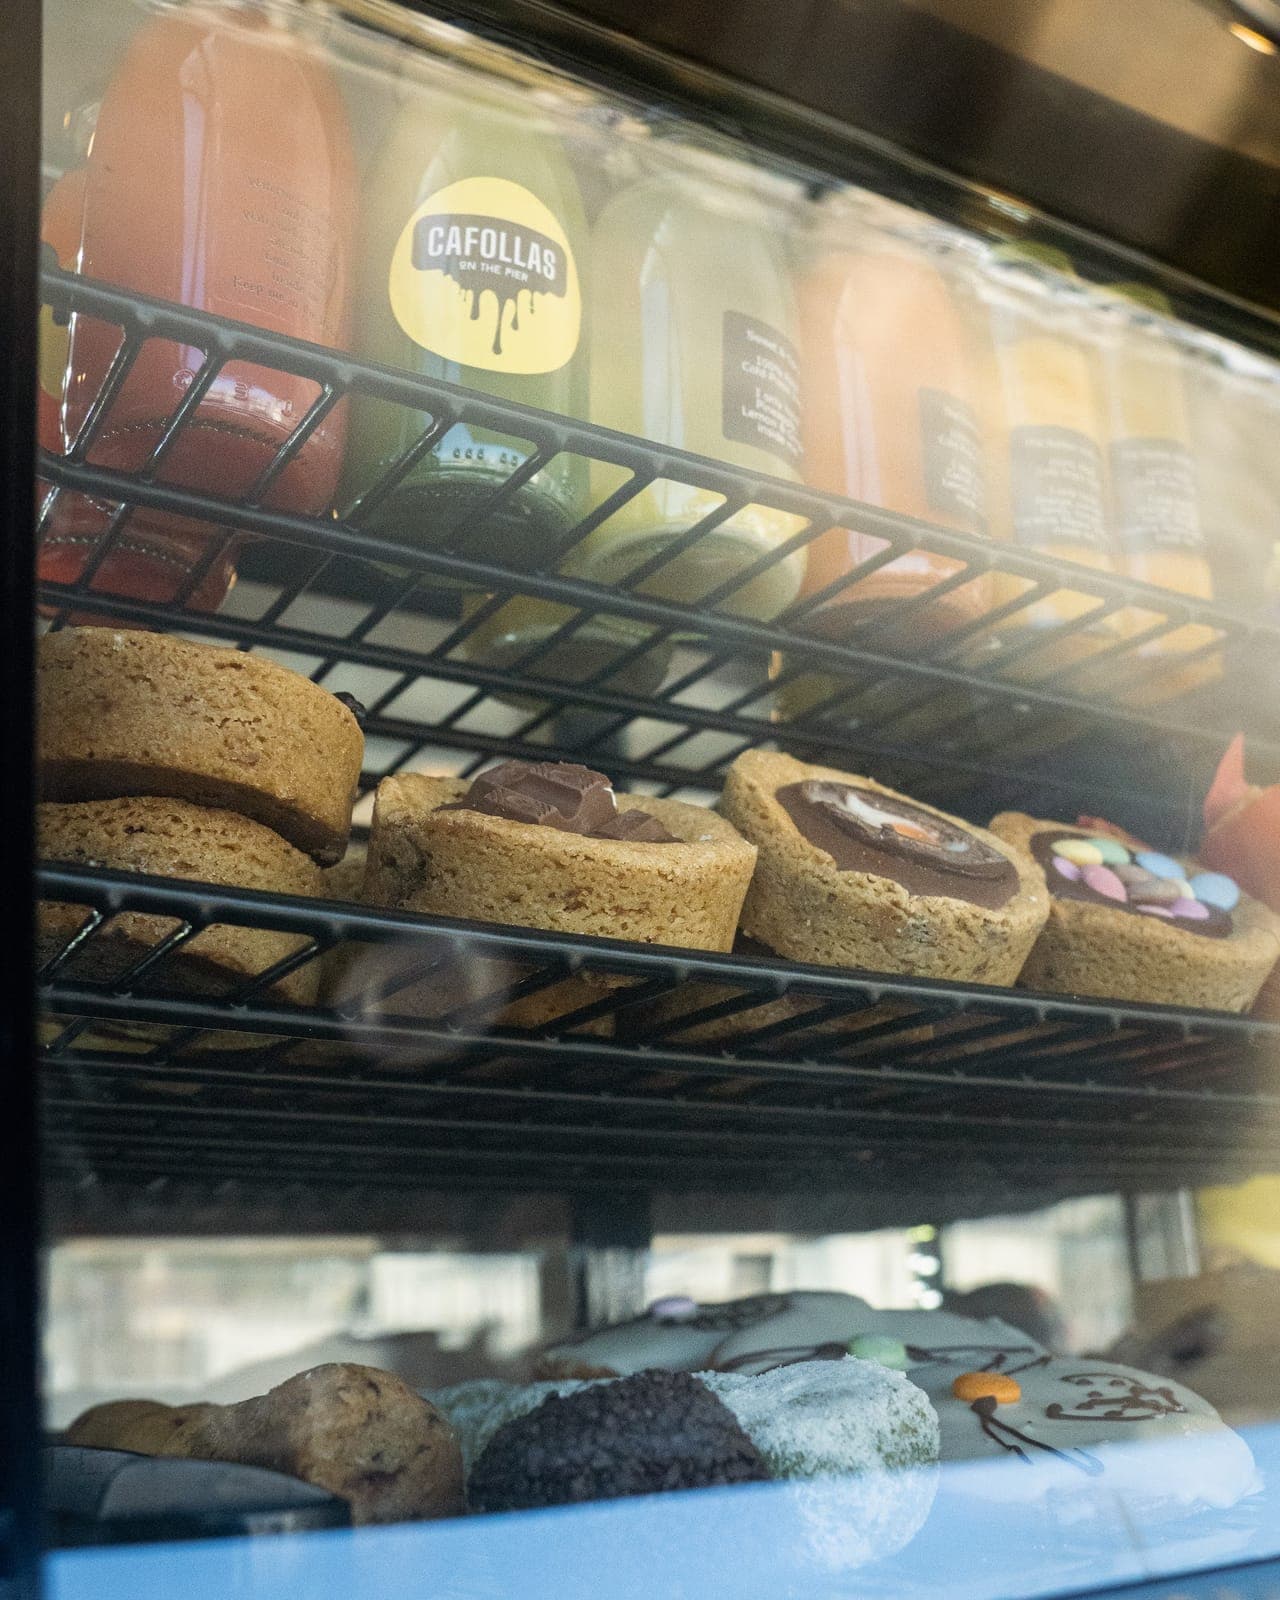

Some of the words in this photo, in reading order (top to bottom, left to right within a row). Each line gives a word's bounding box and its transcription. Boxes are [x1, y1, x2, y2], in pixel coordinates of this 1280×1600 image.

[428, 226, 556, 280] CAFOLLAS
[459, 261, 476, 270] ON
[480, 262, 501, 275] THE
[505, 267, 528, 282] PIER
